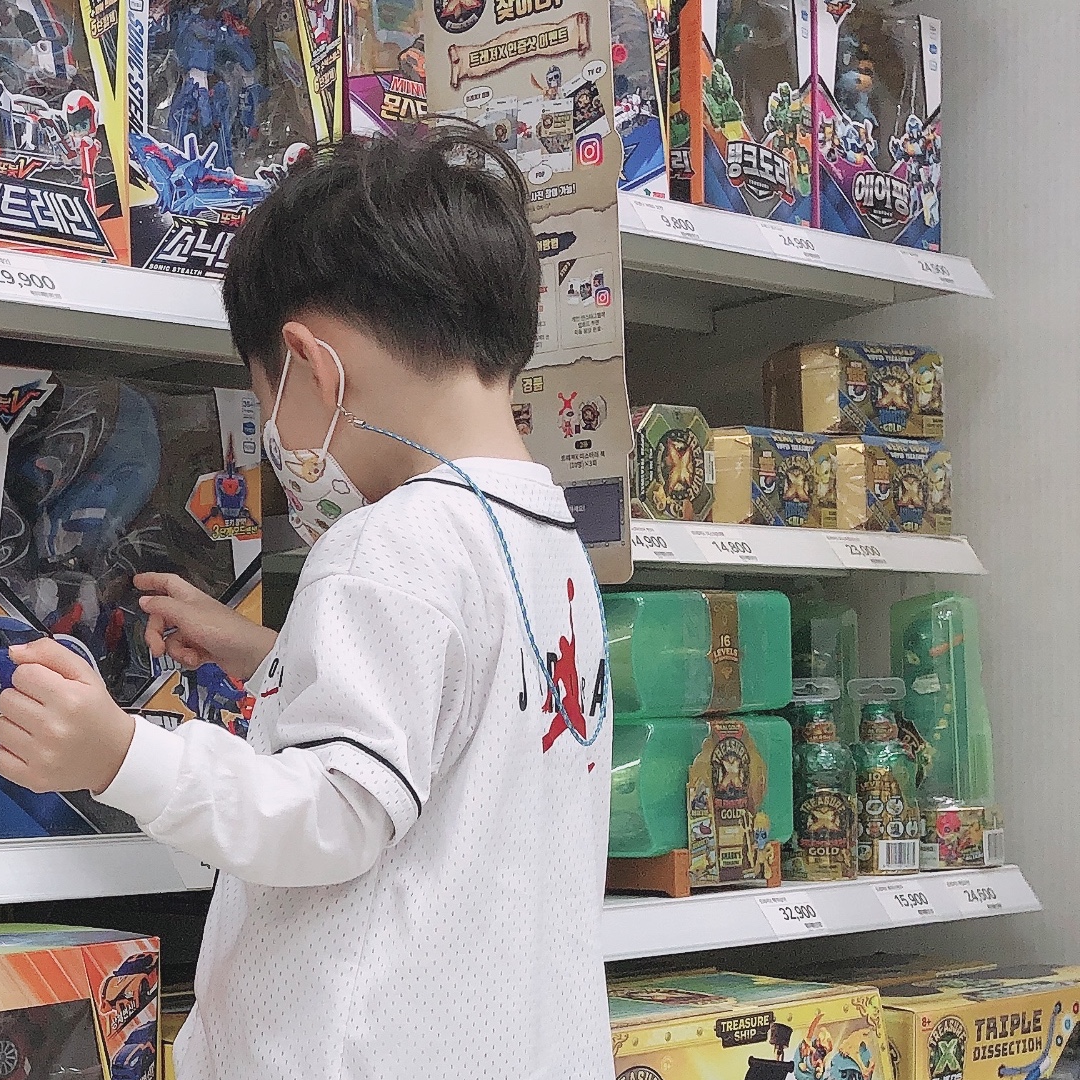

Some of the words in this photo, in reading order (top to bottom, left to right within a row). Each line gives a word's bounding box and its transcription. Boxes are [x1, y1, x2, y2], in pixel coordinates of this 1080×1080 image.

[538, 26, 569, 49] 이벤트
[149, 262, 171, 274] SONIC
[172, 266, 203, 277] STEALTH
[521, 375, 545, 393] 경품
[720, 634, 731, 647] 16
[713, 645, 738, 657] LEVELS
[721, 807, 742, 820] GOLD
[808, 847, 839, 856] GOLD
[720, 1014, 770, 1033] TREASURE
[974, 1009, 1043, 1043] TRIPLE
[734, 1028, 757, 1042] SHIP
[972, 1036, 1043, 1062] DISSECTION
